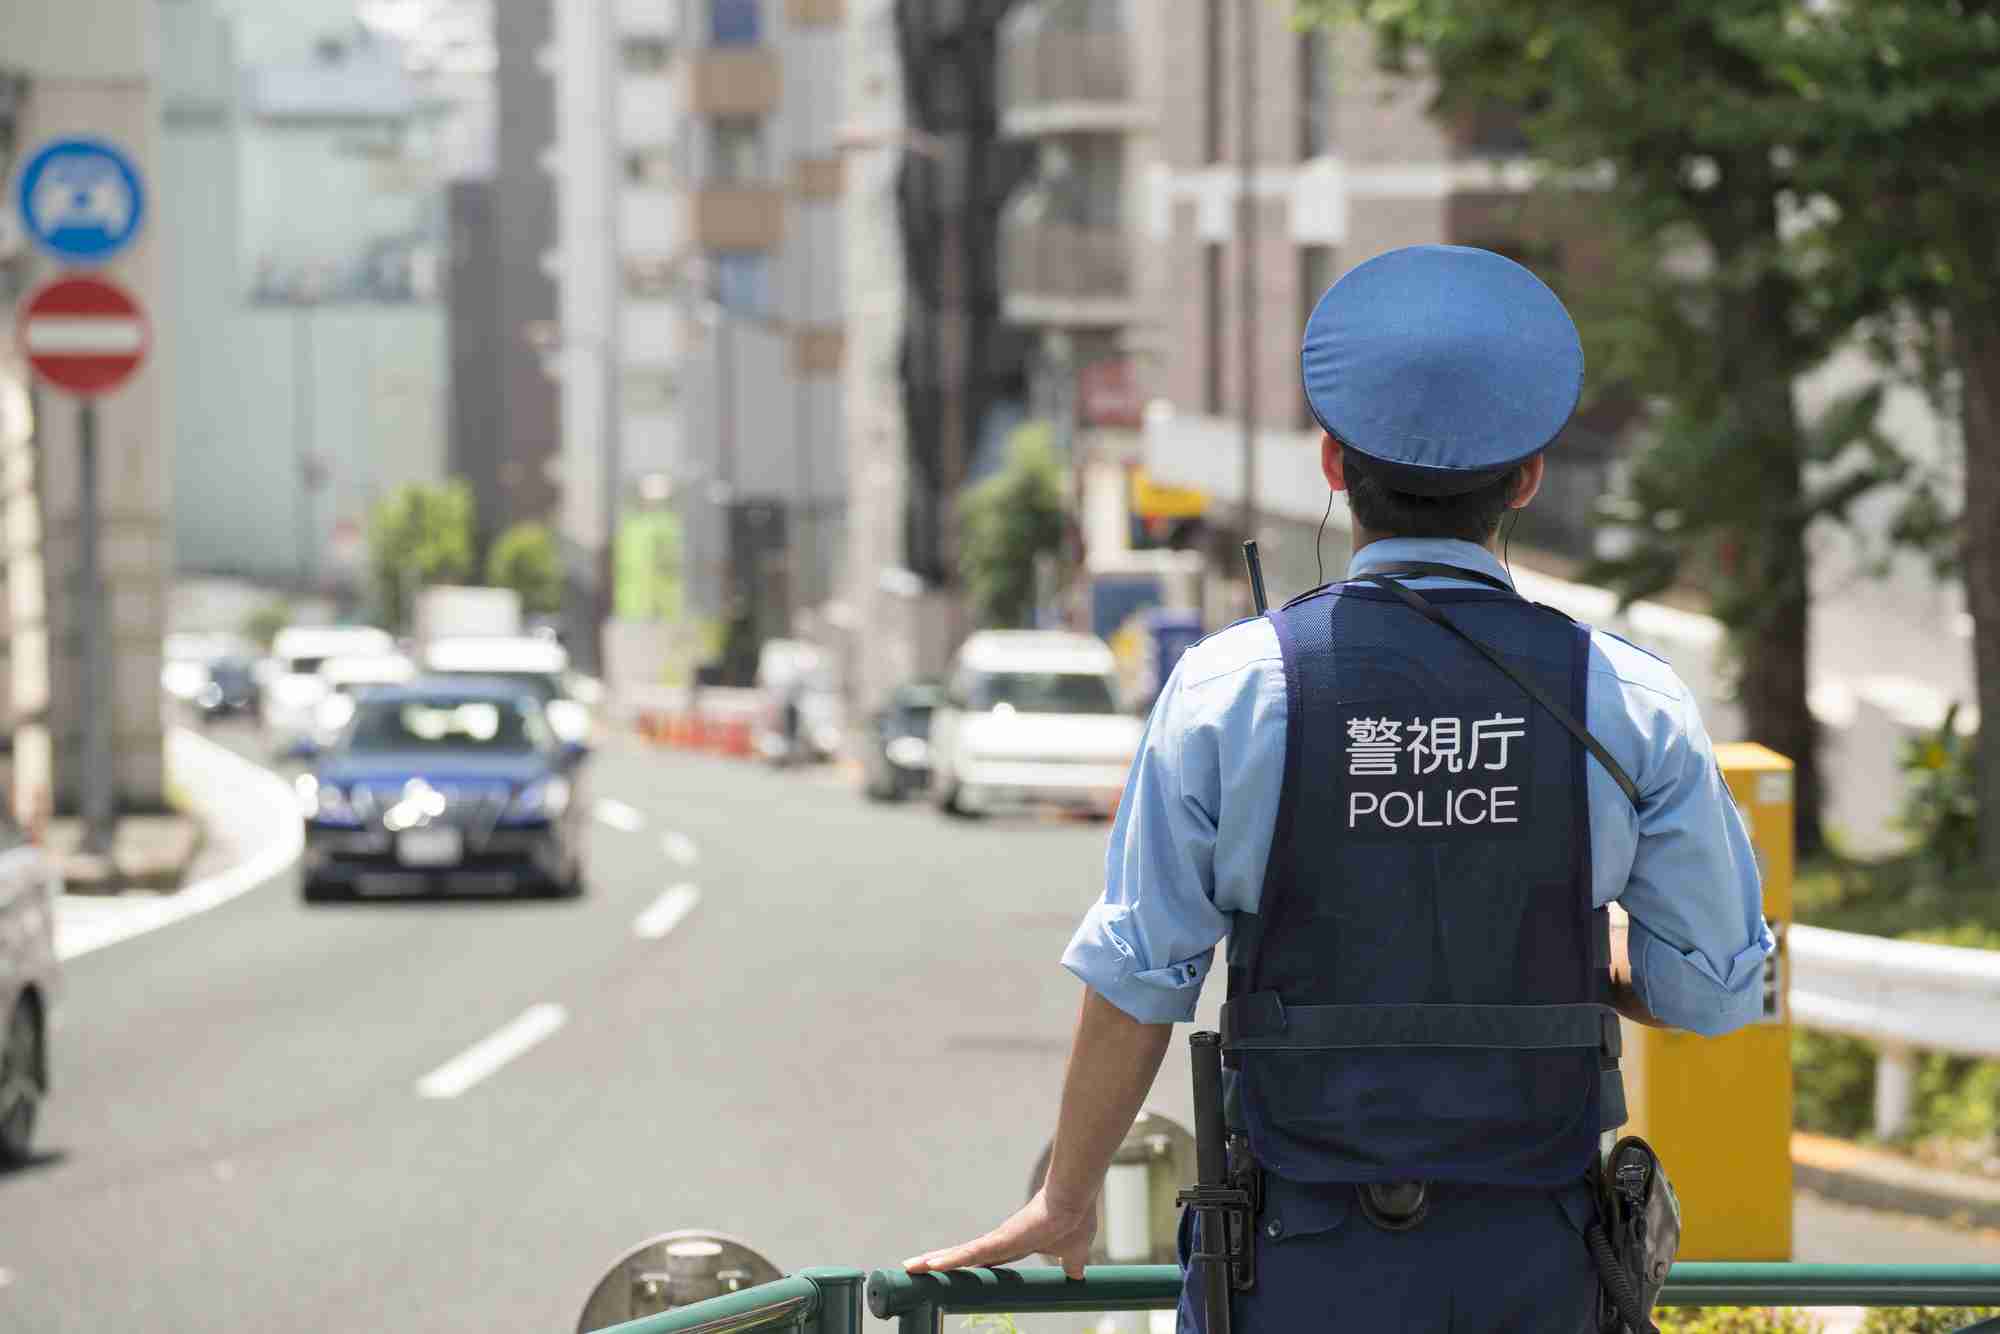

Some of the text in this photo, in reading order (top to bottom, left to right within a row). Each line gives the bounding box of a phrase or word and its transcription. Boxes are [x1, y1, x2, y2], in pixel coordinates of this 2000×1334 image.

[1345, 712, 1526, 775] 警視庁
[1349, 785, 1519, 828] POLICE
